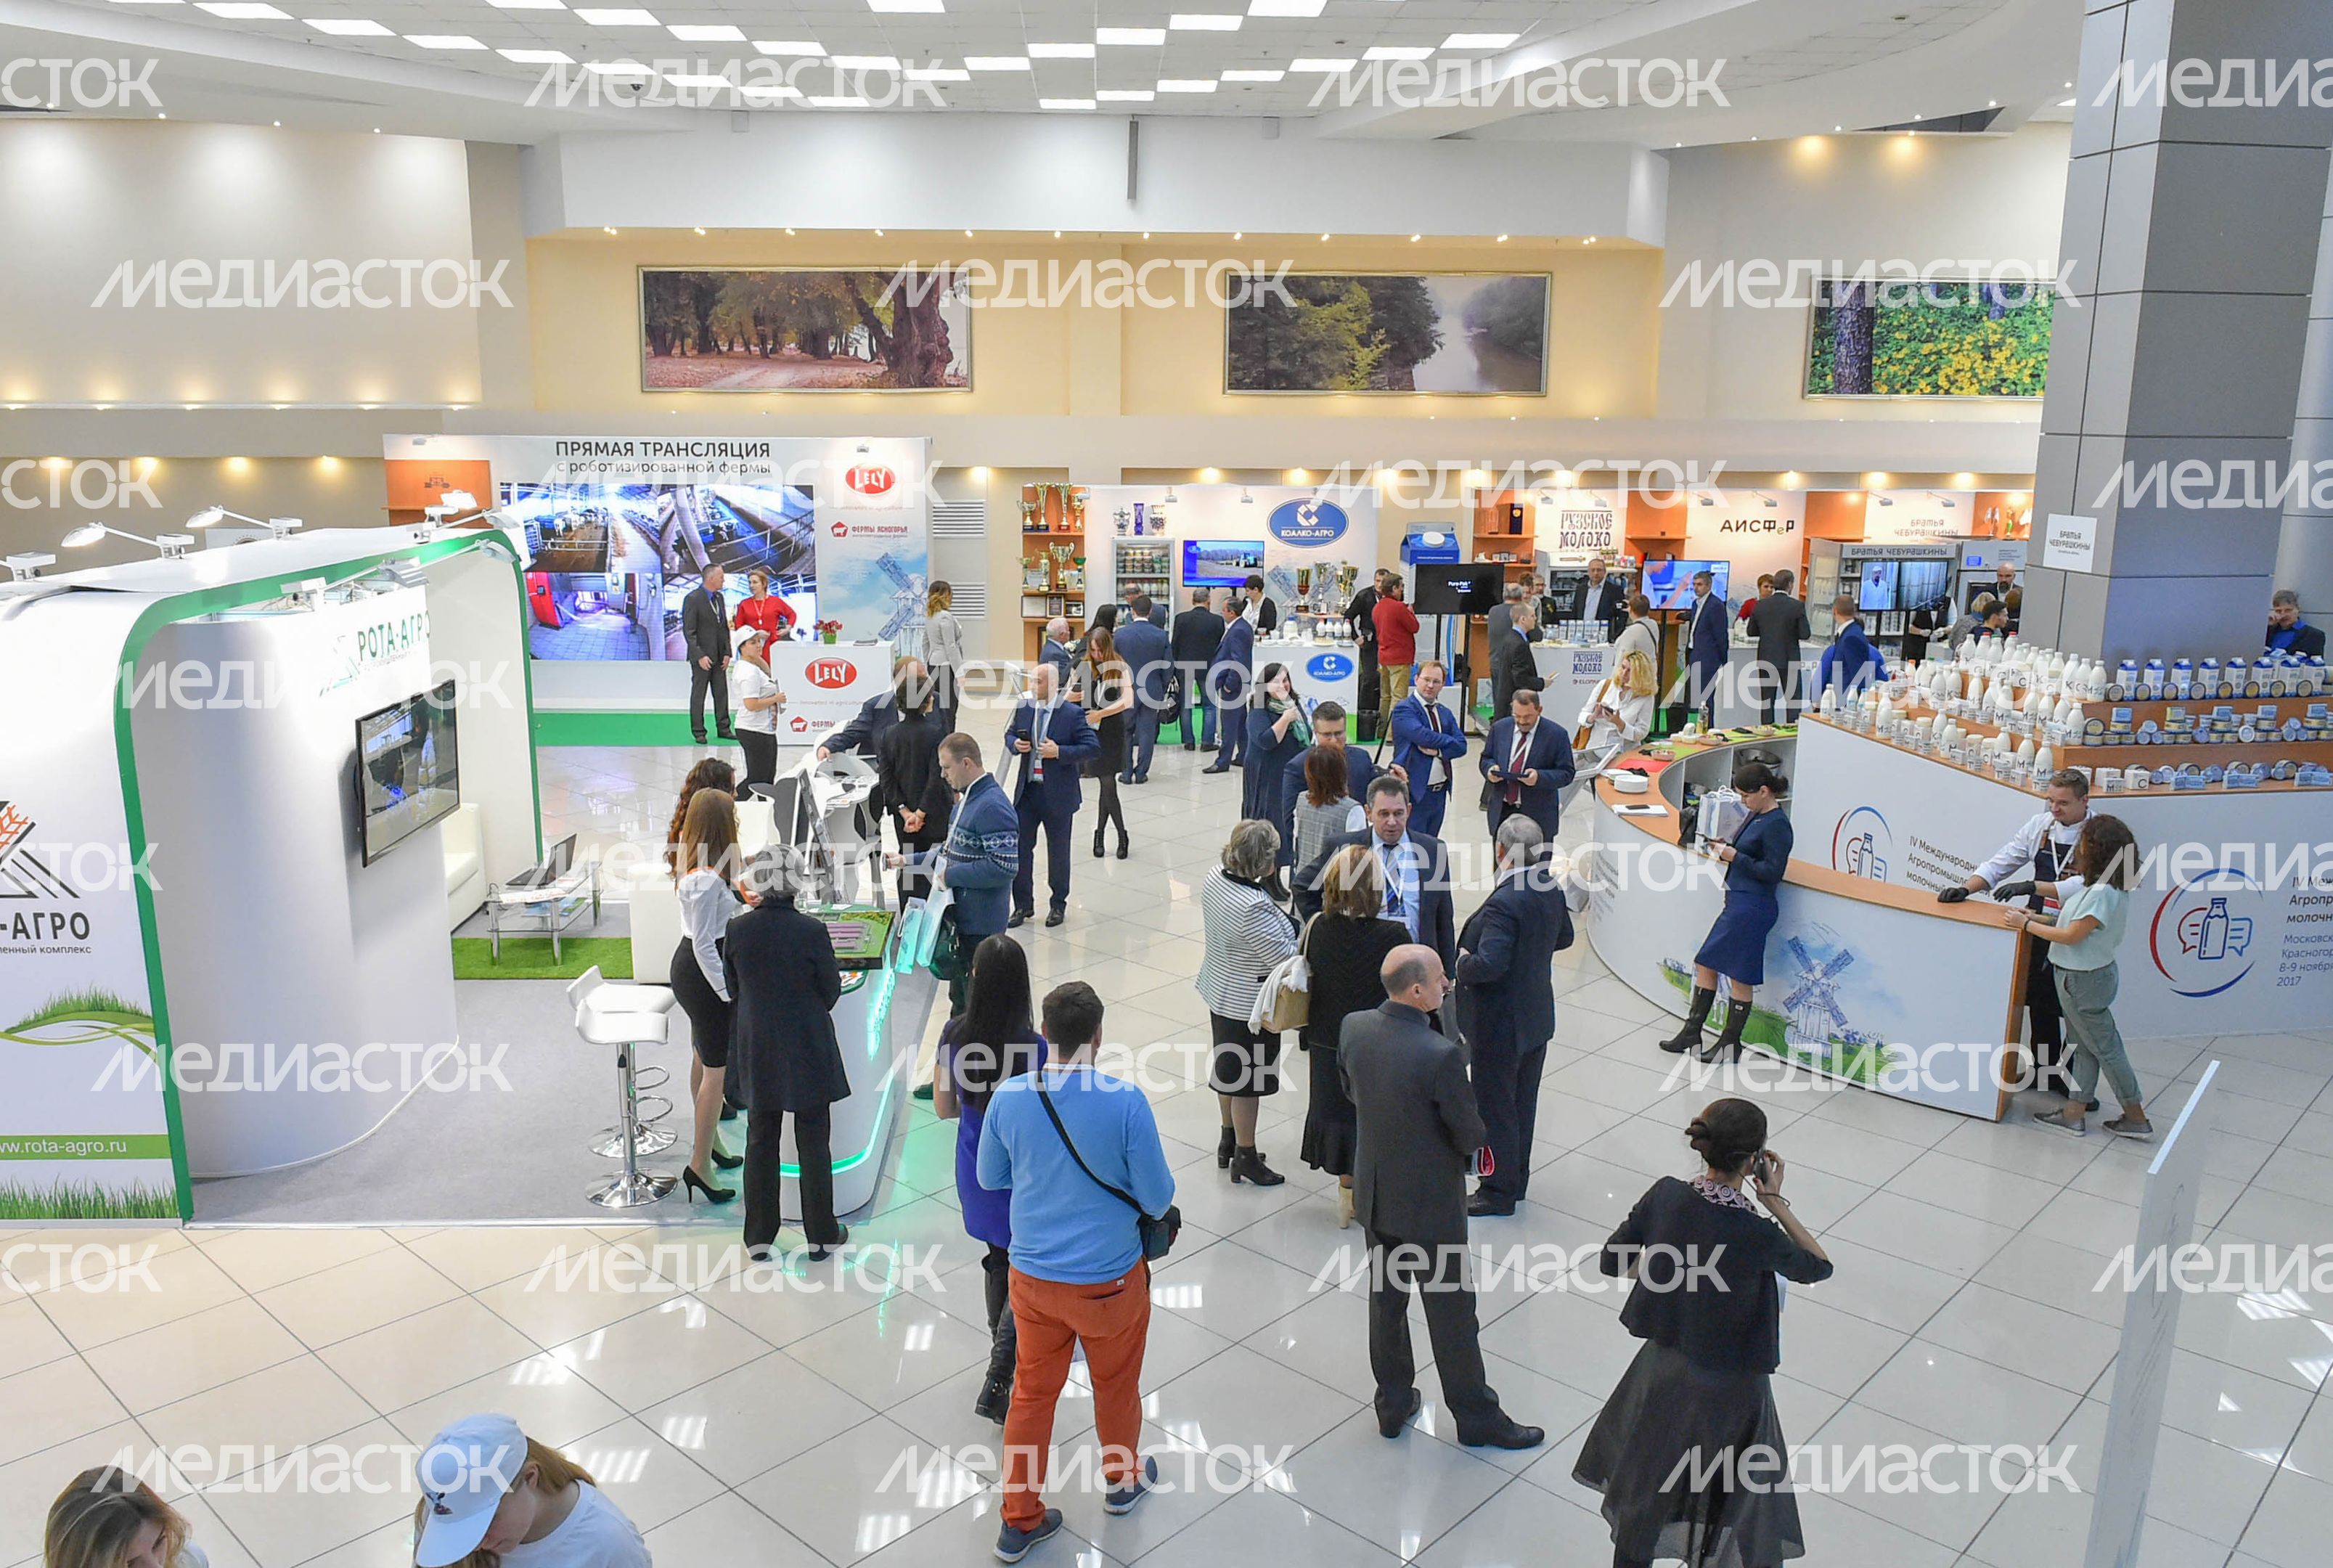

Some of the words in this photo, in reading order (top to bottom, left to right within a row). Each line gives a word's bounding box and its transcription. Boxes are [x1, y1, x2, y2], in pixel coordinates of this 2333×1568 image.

[556, 441, 634, 457] ПРЯМАЯ
[640, 442, 770, 460] ТРАНСЛЯЦИЯ
[557, 463, 565, 473] с
[570, 460, 715, 475] роботизированной
[719, 461, 771, 476] фермы
[855, 468, 886, 490] LELY
[1559, 531, 1611, 549] МОЛОКО
[814, 662, 848, 685] LELY
[2287, 914, 2333, 923] молочн
[2279, 962, 2297, 973] 8-9
[2276, 976, 2302, 987] 2017
